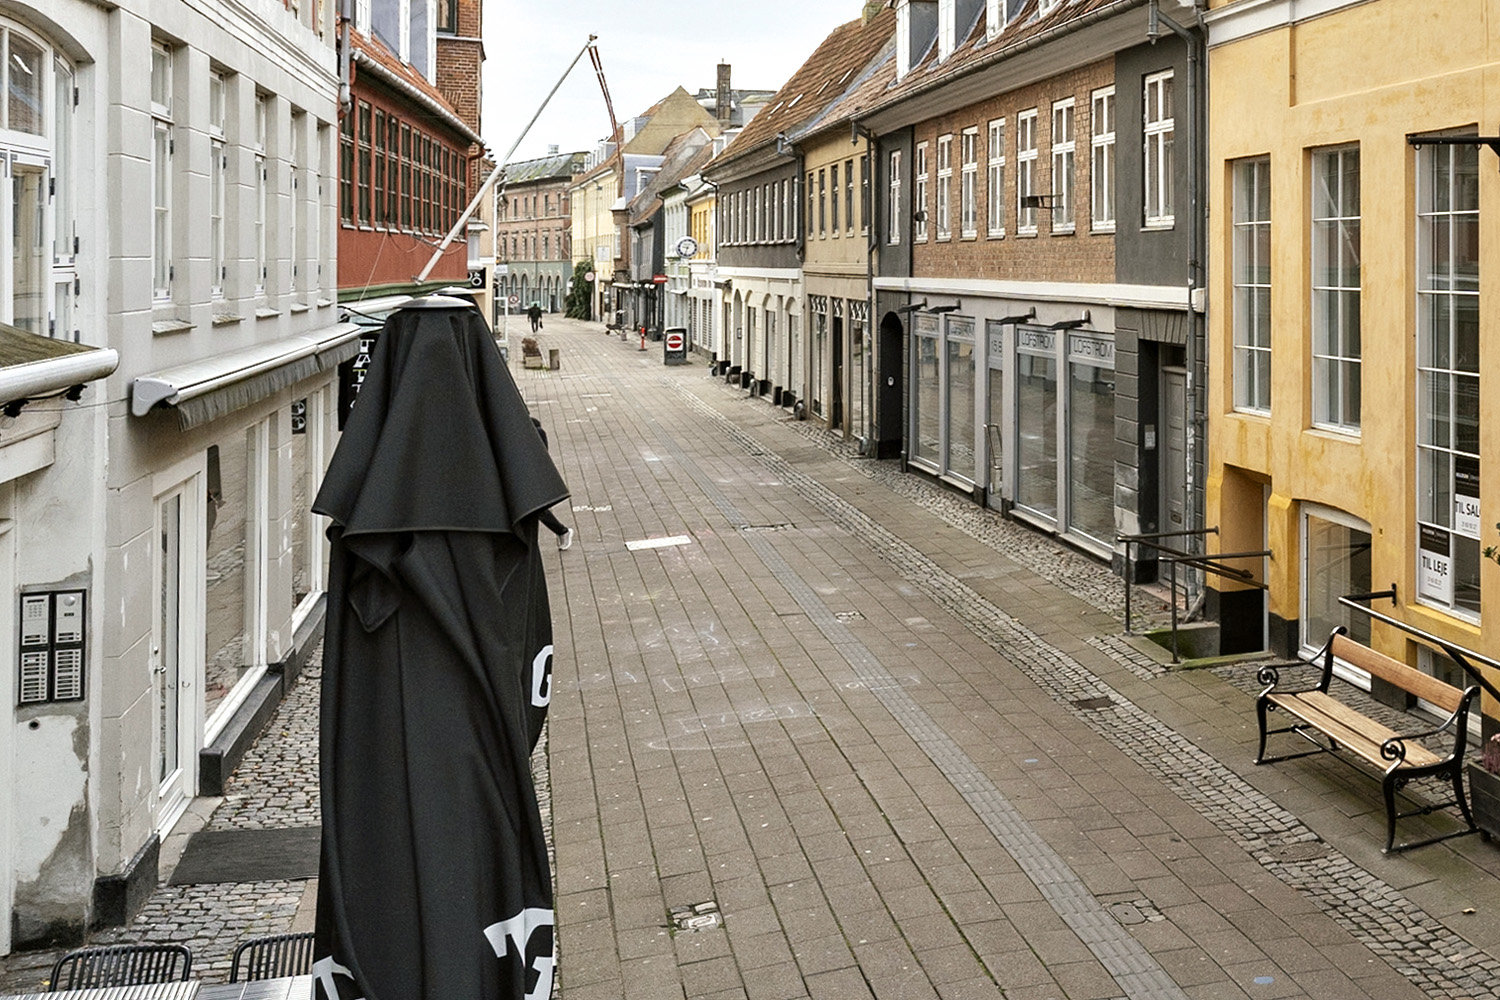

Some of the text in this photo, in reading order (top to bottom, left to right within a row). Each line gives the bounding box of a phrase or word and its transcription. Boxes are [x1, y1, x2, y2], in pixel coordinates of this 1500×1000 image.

[1455, 501, 1480, 518] TIL SAL
[1422, 555, 1448, 577] TIL LEJE
